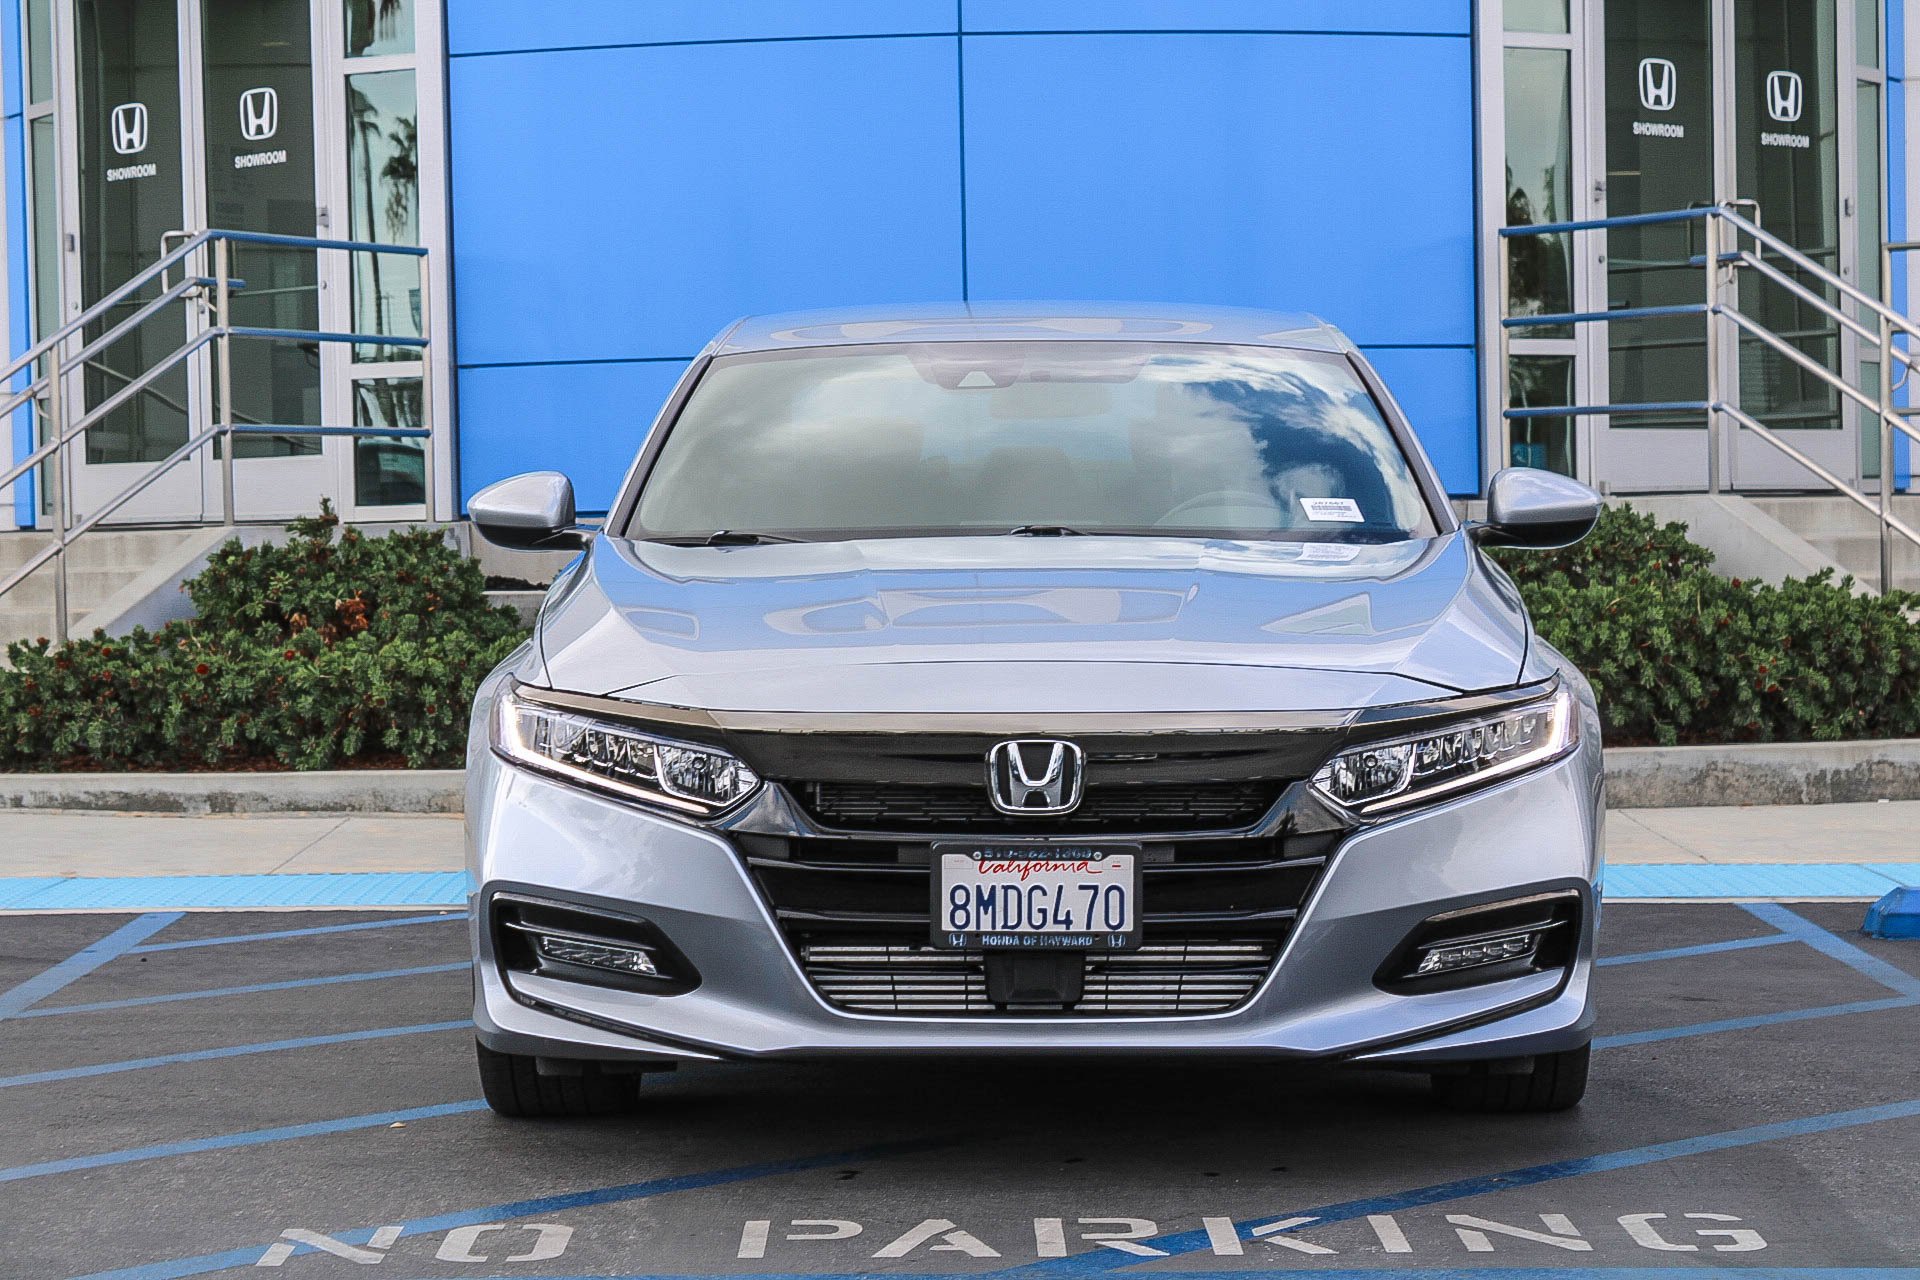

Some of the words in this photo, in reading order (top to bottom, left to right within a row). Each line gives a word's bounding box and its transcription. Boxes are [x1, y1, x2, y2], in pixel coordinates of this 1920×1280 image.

[1632, 121, 1685, 138] SHOWROOM
[1760, 132, 1810, 148] SHOWROOM
[234, 149, 287, 169] SHOWROOM
[106, 163, 157, 182] SHOWROOM
[978, 860, 1103, 881] California
[949, 884, 1126, 931] 8MDG470
[982, 935, 1020, 946] HONDA
[1023, 935, 1038, 946] OF
[1040, 935, 1093, 946] HAYWARD
[255, 1222, 575, 1268] NO
[736, 1212, 1768, 1259] PARKING
